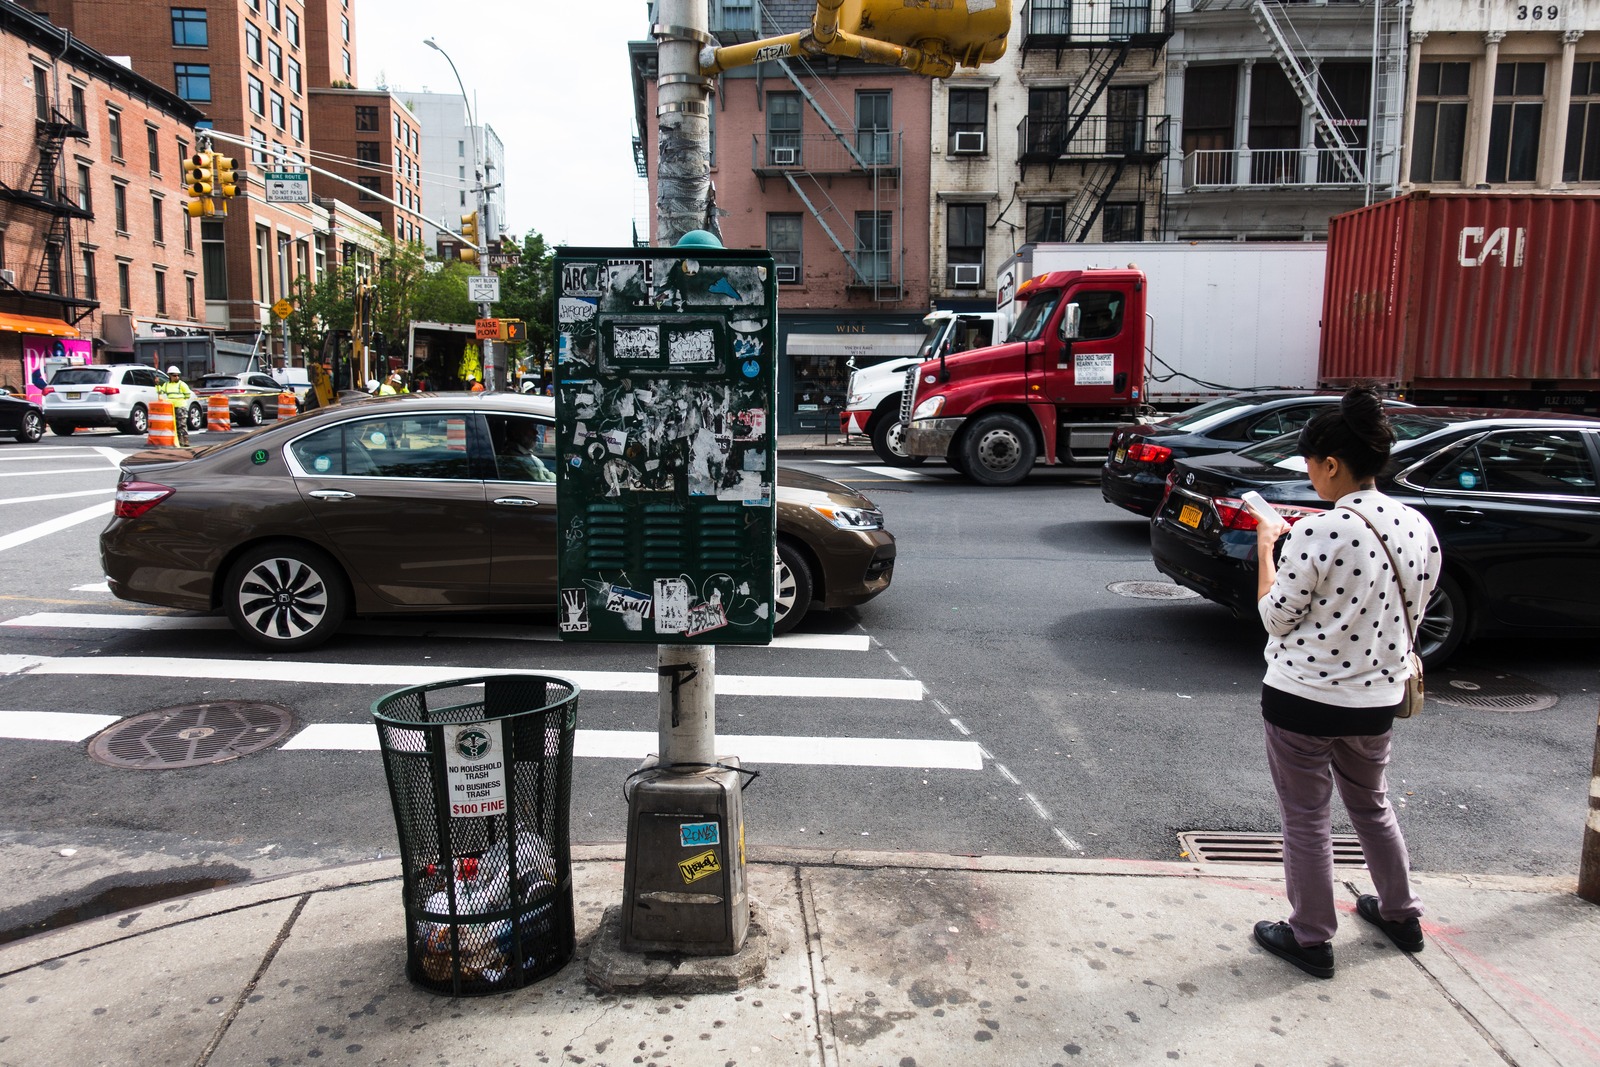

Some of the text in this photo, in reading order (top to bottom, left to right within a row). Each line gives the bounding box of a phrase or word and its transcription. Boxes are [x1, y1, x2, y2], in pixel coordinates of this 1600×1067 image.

[1517, 5, 1558, 20] 369
[1458, 226, 1526, 268] CAI
[490, 256, 520, 264] CANAL ST
[564, 623, 588, 631] TAP
[460, 762, 502, 773] HOUSEHOLD
[465, 771, 488, 780] TRASH
[466, 780, 500, 791] BUSINESS
[466, 790, 490, 798] TRASH
[452, 800, 504, 815] $100 FINE
